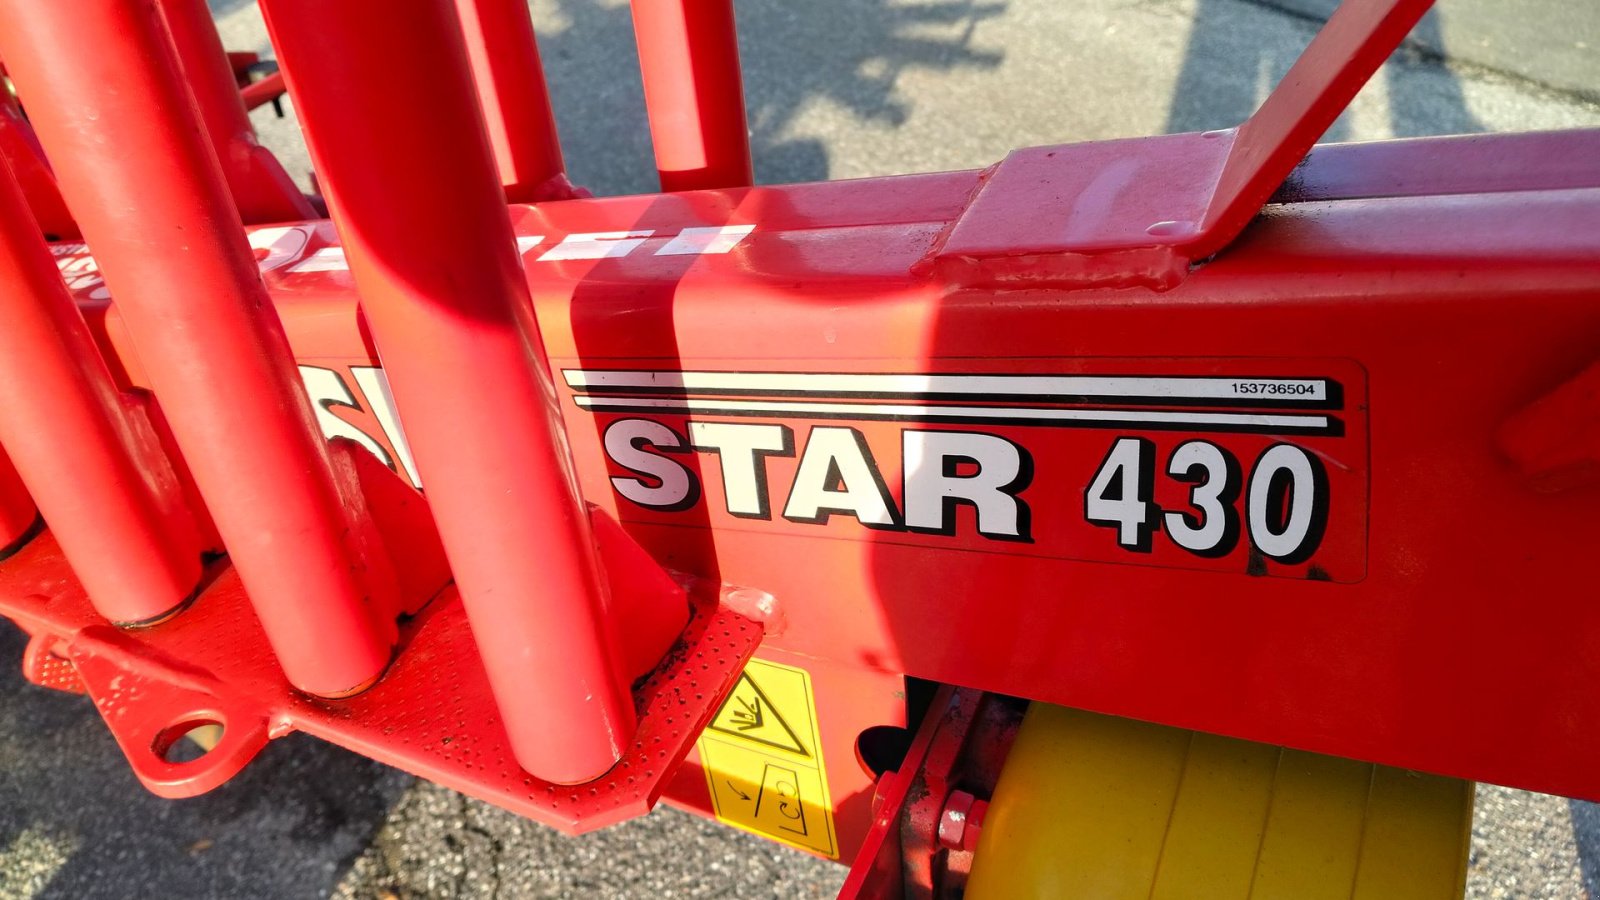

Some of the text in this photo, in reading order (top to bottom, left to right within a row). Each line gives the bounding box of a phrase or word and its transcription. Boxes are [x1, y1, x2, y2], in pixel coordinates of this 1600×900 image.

[1231, 383, 1315, 395] 153736504
[604, 418, 1329, 564] STAR 430
